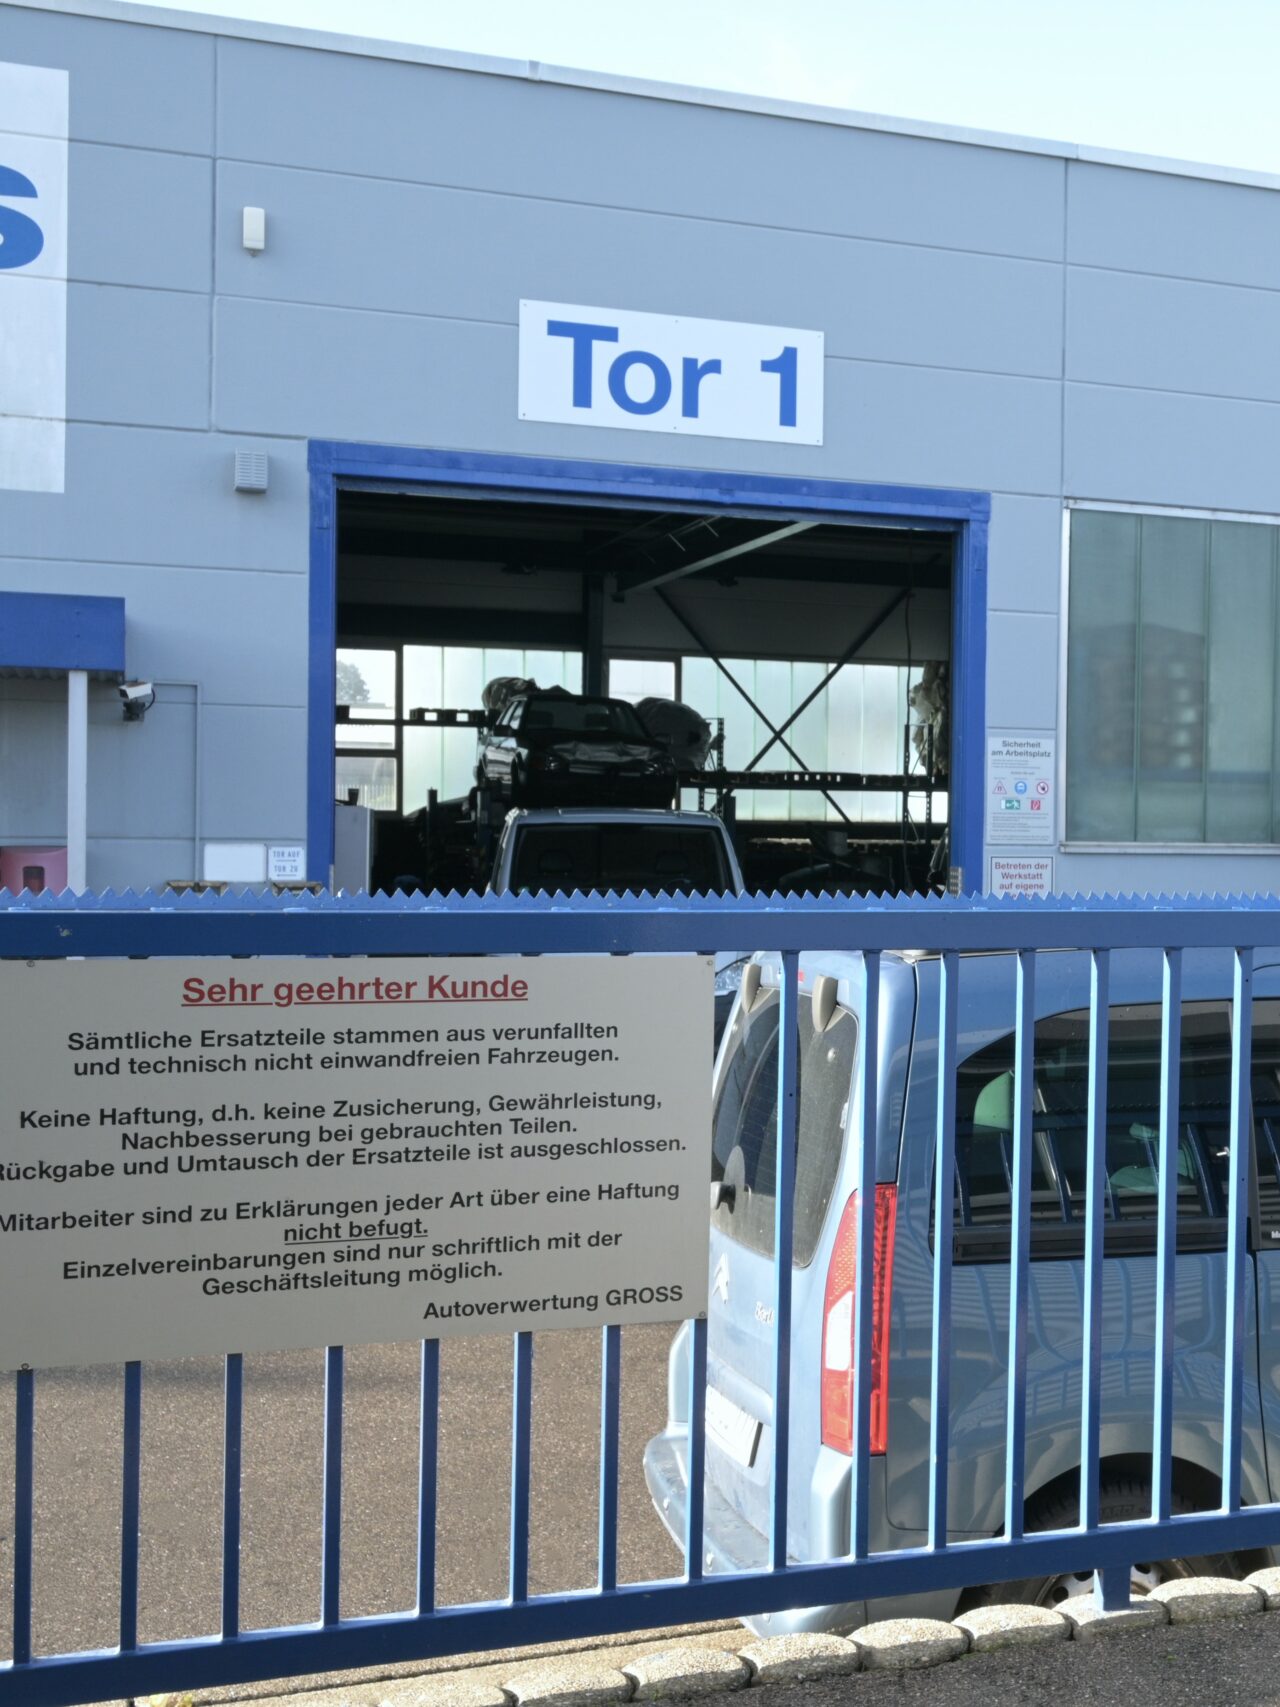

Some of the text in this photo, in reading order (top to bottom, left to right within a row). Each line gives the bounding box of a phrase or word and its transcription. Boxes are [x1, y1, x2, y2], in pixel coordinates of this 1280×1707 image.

[547, 319, 798, 428] Tor 1
[1002, 740, 1041, 748] Sicherheit
[1005, 749, 1051, 758] Arbeitsplatz
[994, 862, 1048, 870] Betreten der
[1001, 872, 1043, 880] Werkstatt
[999, 882, 1044, 891] auf eigene
[181, 974, 529, 1007] Sehr geehrter Kunde
[67, 1021, 619, 1052] Sämtliche Ersatzteile stammen aus verunfallten
[73, 1046, 620, 1077] und technisch nicht einwandfreien Fahrzeugen.
[19, 1091, 662, 1130] Keine Haftung, d.h. keine Zusicherung, Gewährleistung,
[121, 1116, 578, 1151] Nachbesserung bei gebrauchten Teilen.
[0, 1136, 687, 1184] ückgabe und Umtausch der Ersatzteile ist ausgeschlossen.
[0, 1182, 680, 1233] Mitarbeiter sind zu Erklärungen jeder Art über eine Haftung
[284, 1217, 429, 1242] nicht befugt.
[63, 1230, 623, 1279] Einzelvereinbarungen sind nur schriftlich mit der
[201, 1260, 503, 1296] Geschäftsleitung möglich.
[422, 1284, 684, 1320] Autoverwertung GROSS
